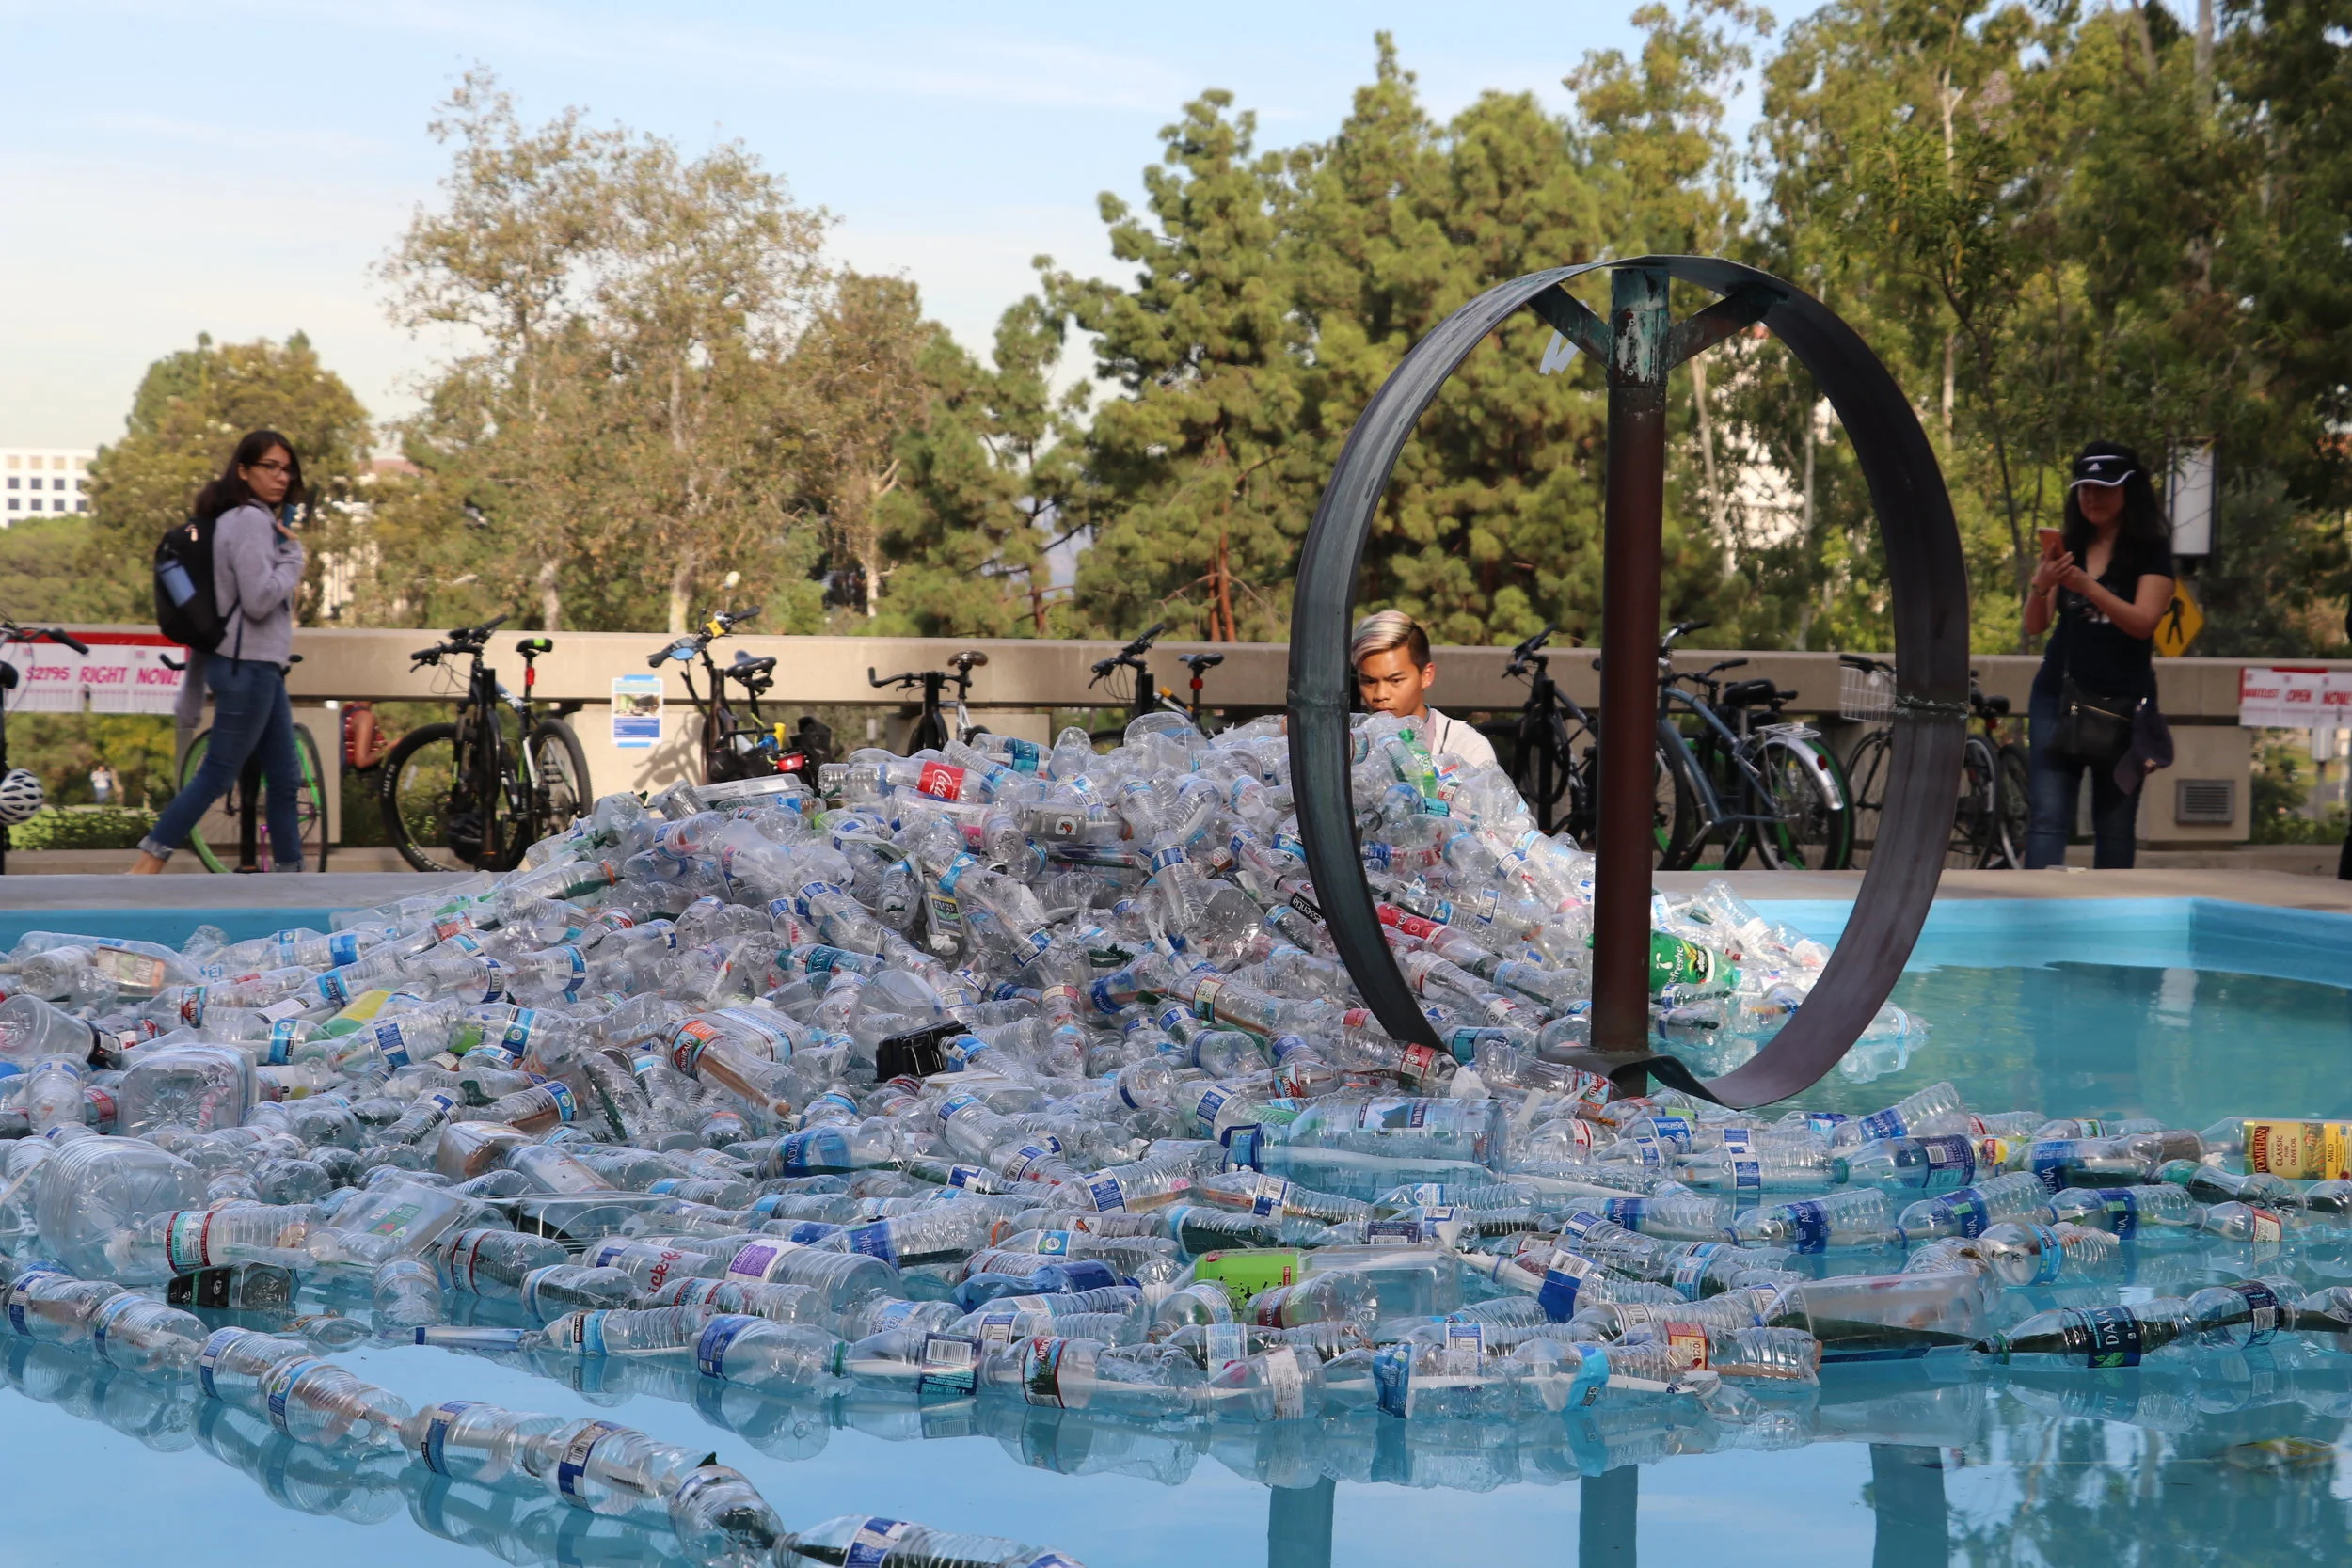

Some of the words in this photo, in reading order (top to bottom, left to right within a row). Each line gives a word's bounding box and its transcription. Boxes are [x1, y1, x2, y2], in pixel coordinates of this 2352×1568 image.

[25, 666, 71, 682] $2795
[79, 666, 128, 685] RIGHT
[135, 668, 180, 686] NOW!
[929, 769, 953, 798] Coca
[2275, 1135, 2284, 1167] CLASSIC
